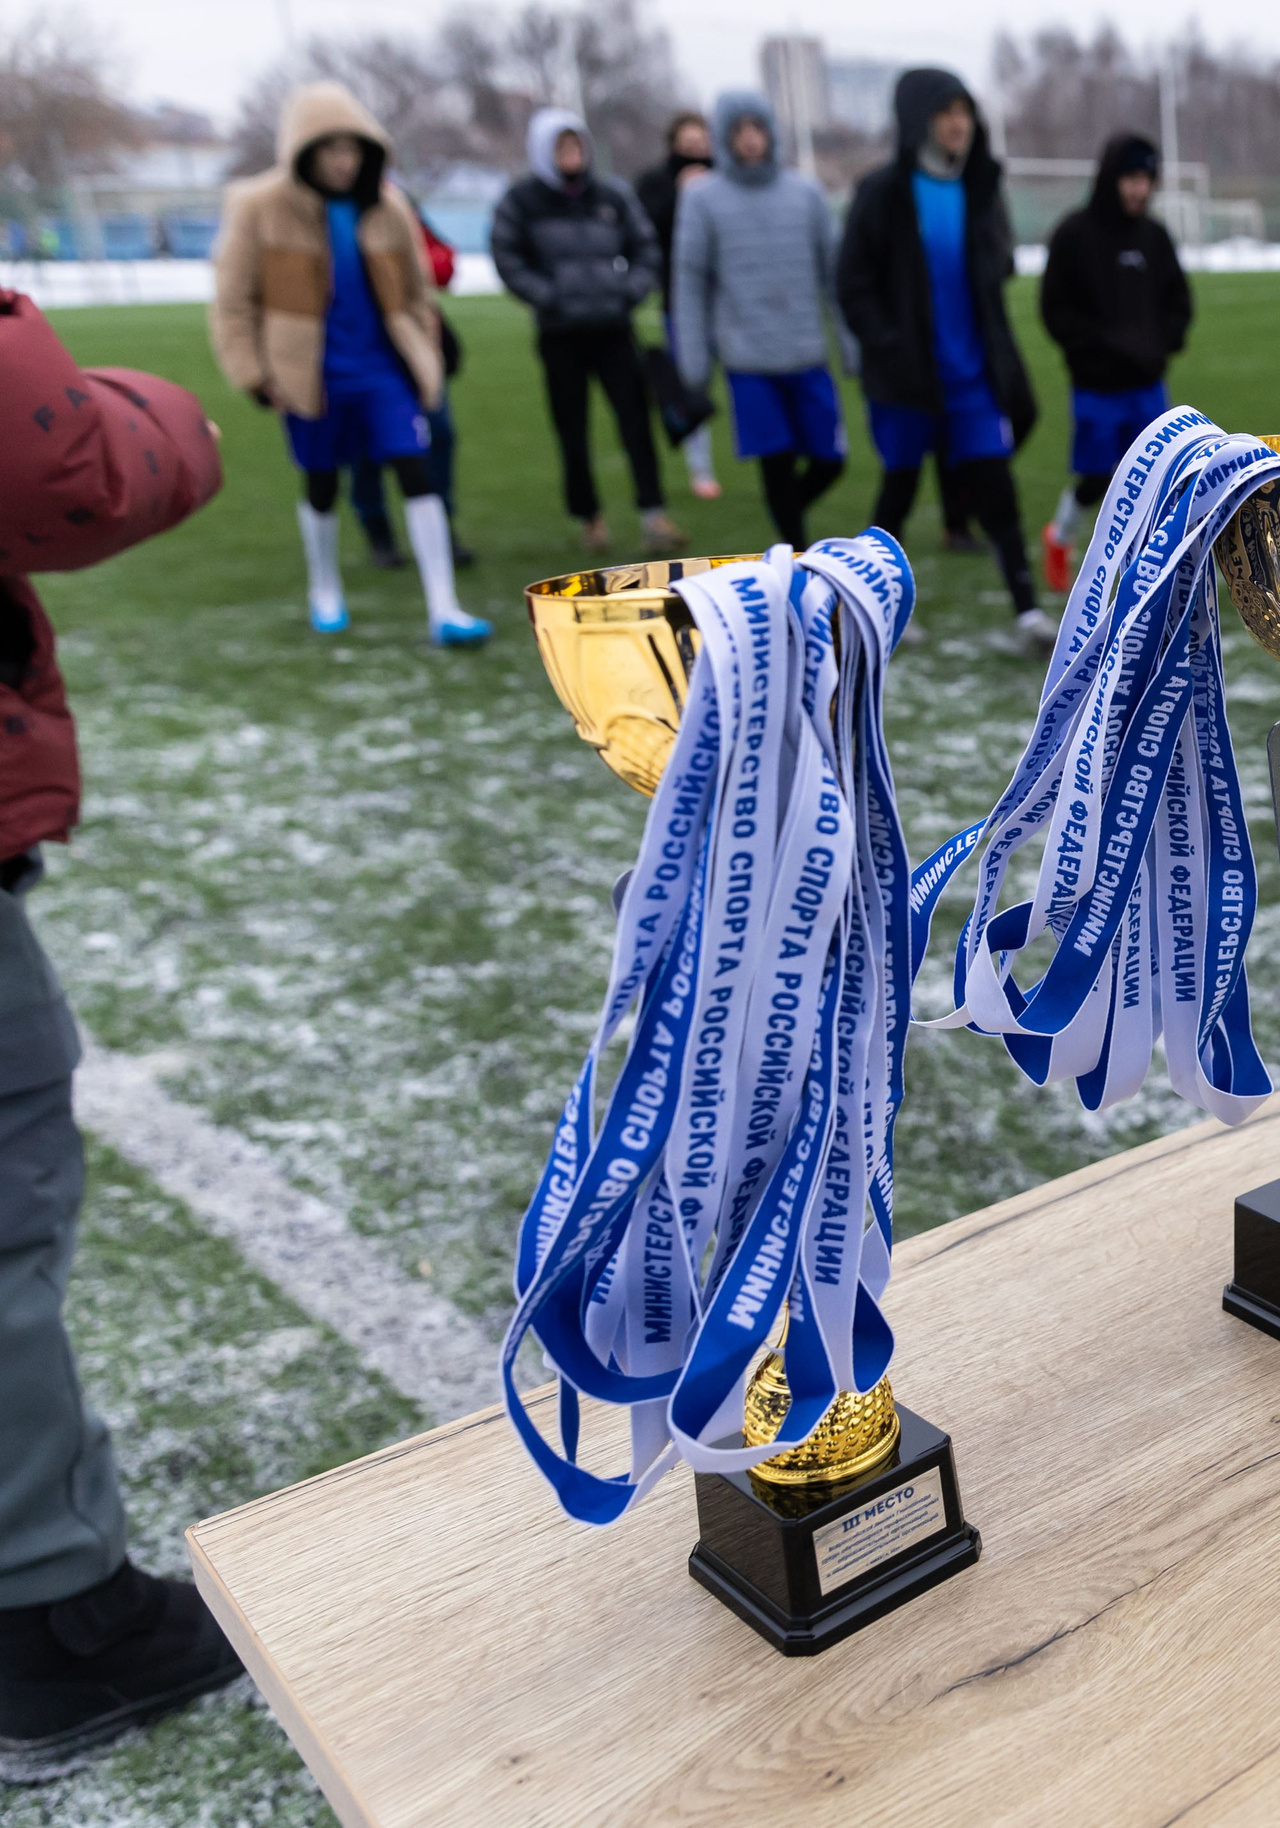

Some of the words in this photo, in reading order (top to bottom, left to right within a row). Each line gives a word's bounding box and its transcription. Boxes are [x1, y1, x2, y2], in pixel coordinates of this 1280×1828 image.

[731, 576, 771, 838] МИНИСТЕРСТВО
[1025, 688, 1082, 770] СПОРТА
[1166, 738, 1195, 859] СИЙСКОЙ
[714, 852, 754, 977] СПОРТА
[778, 846, 834, 960] СПОРТА
[1167, 864, 1197, 1002] ФЕДЕРАЦИИ
[681, 986, 734, 1188] РОССИЙСКОЙ
[745, 971, 802, 1150] РОССИЙСКОЙ
[644, 1173, 675, 1344] МИНИСТЕРСТ
[814, 1104, 851, 1286] ФЕДЕРАЦИИ
[842, 1515, 862, 1533] III
[864, 1486, 915, 1521] МЕСТО
